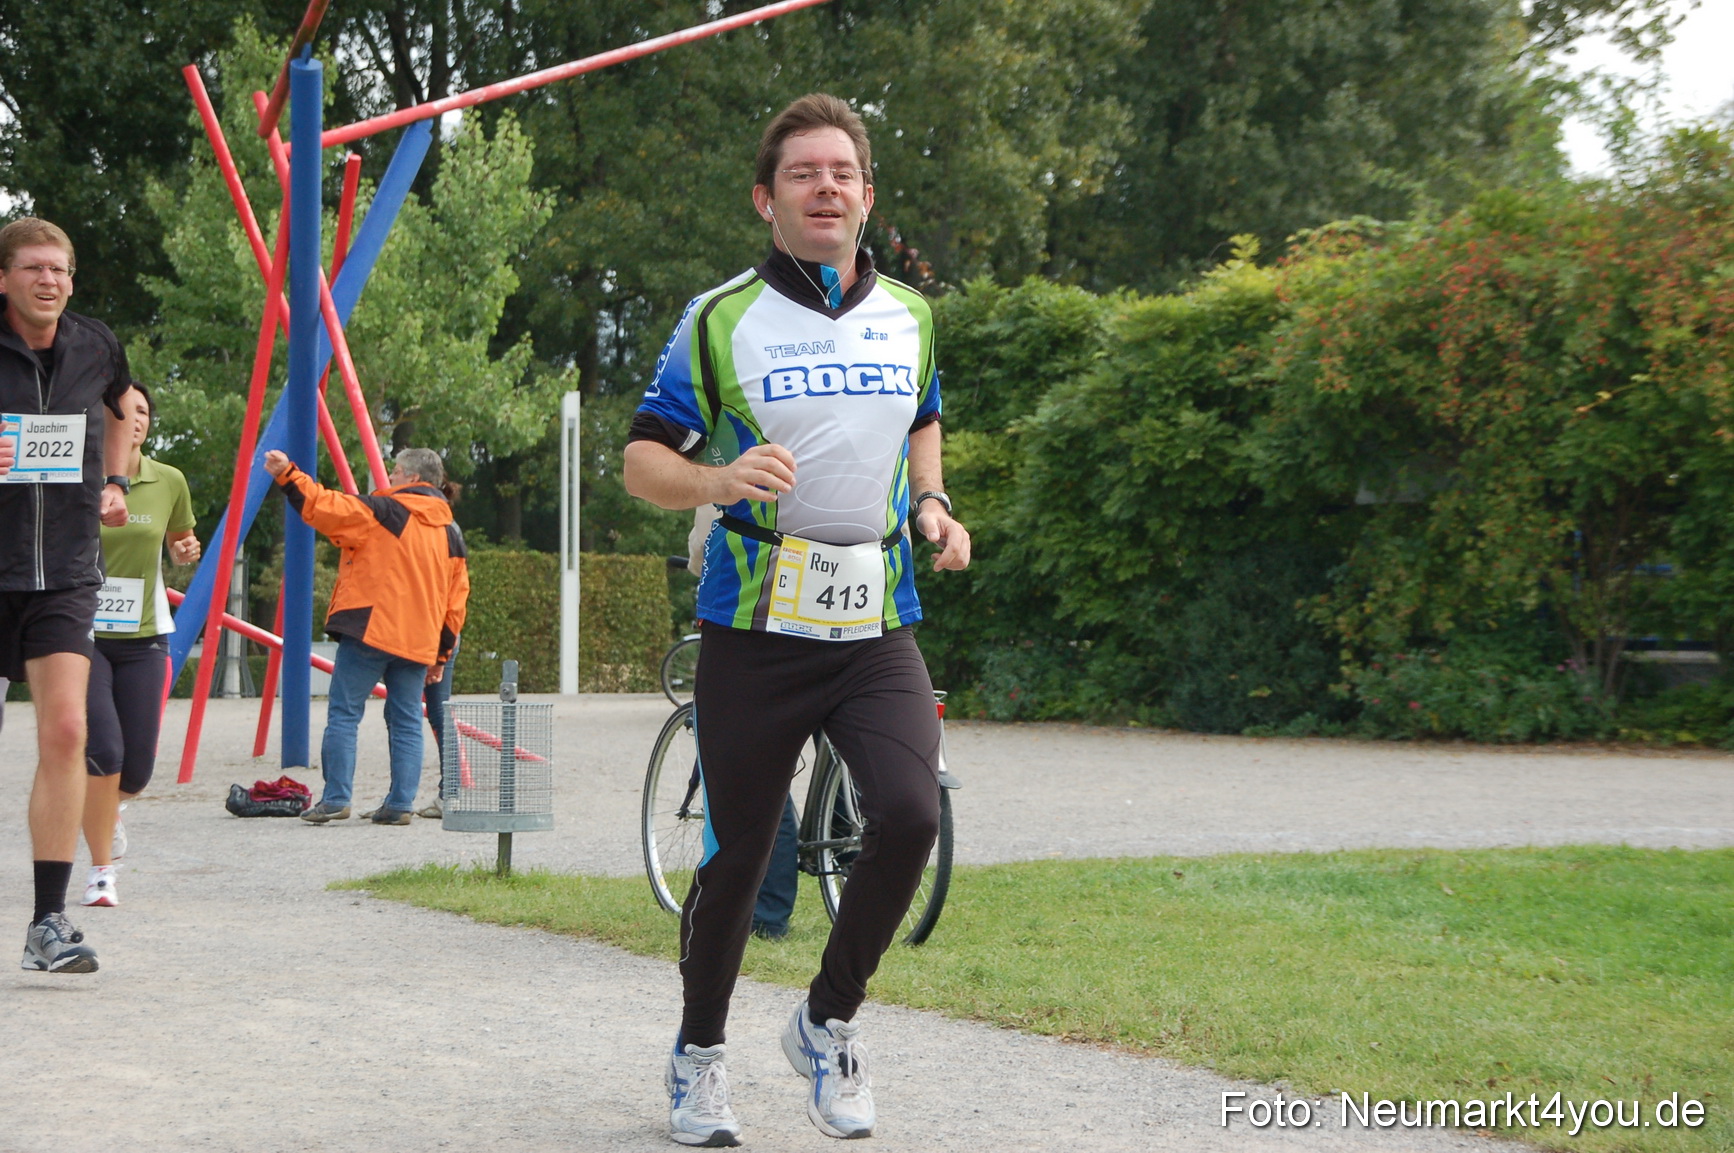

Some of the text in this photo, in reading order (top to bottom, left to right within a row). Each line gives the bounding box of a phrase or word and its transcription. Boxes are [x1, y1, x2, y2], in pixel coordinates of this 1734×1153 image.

[764, 340, 836, 359] TEAM
[762, 363, 918, 403] BOCK
[26, 421, 68, 434] Joachim
[25, 441, 74, 458] 2022
[810, 552, 839, 578] Roy
[100, 584, 122, 593] abine
[778, 574, 788, 588] C
[96, 598, 135, 612] 2227
[815, 584, 869, 611] 413
[842, 622, 880, 635] PFLEIDERER
